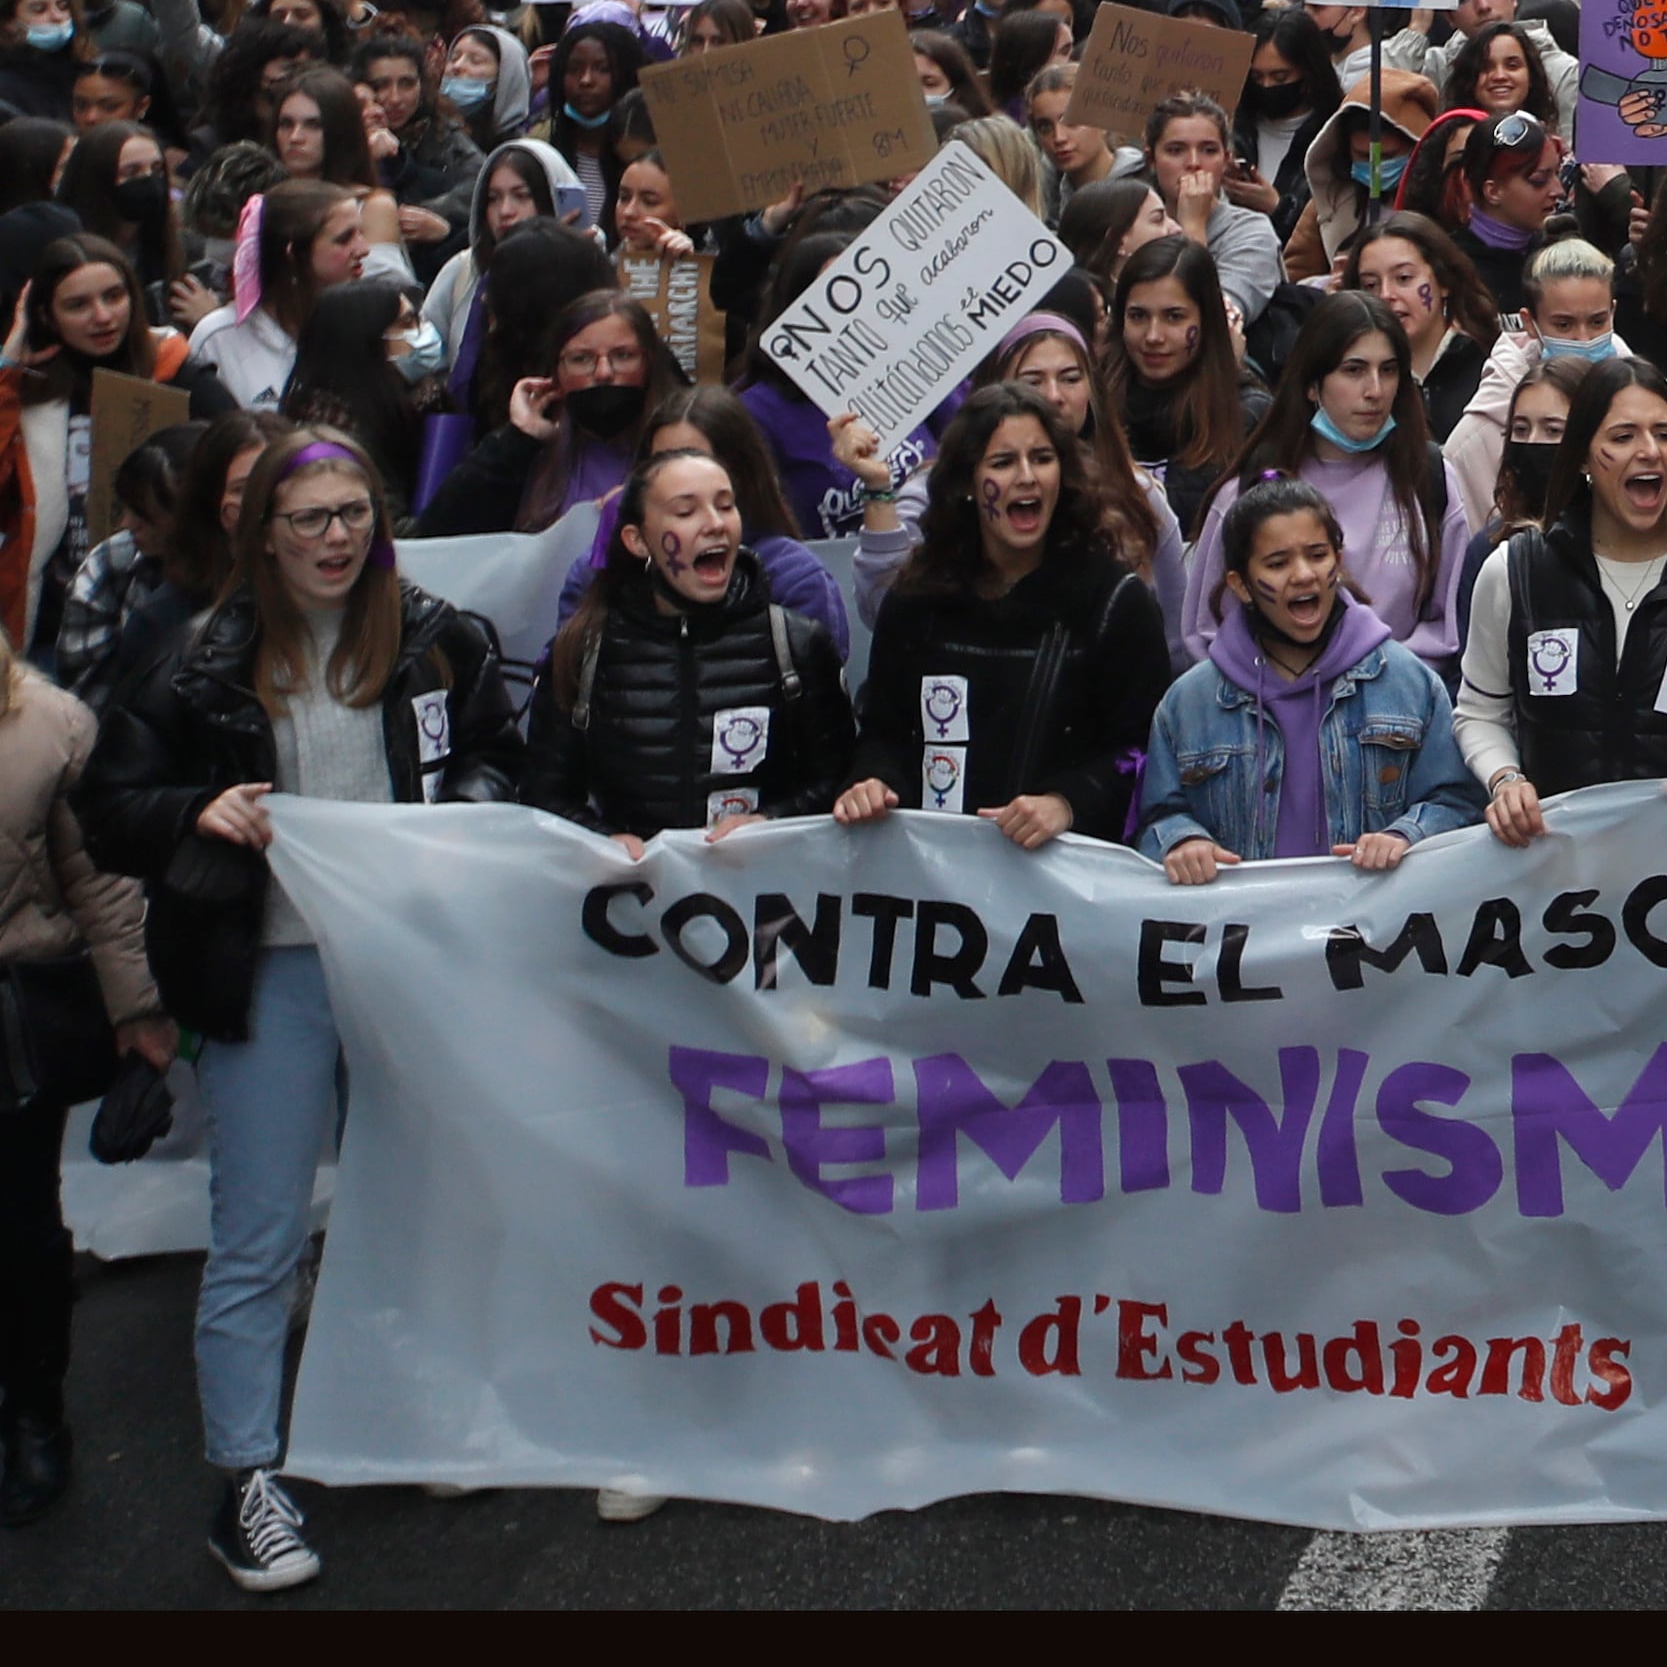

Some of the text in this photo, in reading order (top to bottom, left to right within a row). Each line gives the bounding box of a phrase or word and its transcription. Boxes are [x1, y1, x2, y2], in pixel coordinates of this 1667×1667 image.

[781, 151, 986, 352] NOS QUITARON
[804, 207, 994, 397] TANTO acabaron
[966, 238, 1058, 331] MIEDO
[582, 882, 1084, 1006] CONTRA
[1137, 920, 1283, 1006] EL
[587, 1277, 1003, 1378] Sindicat
[1018, 1291, 1634, 1413] d'Estudiants
